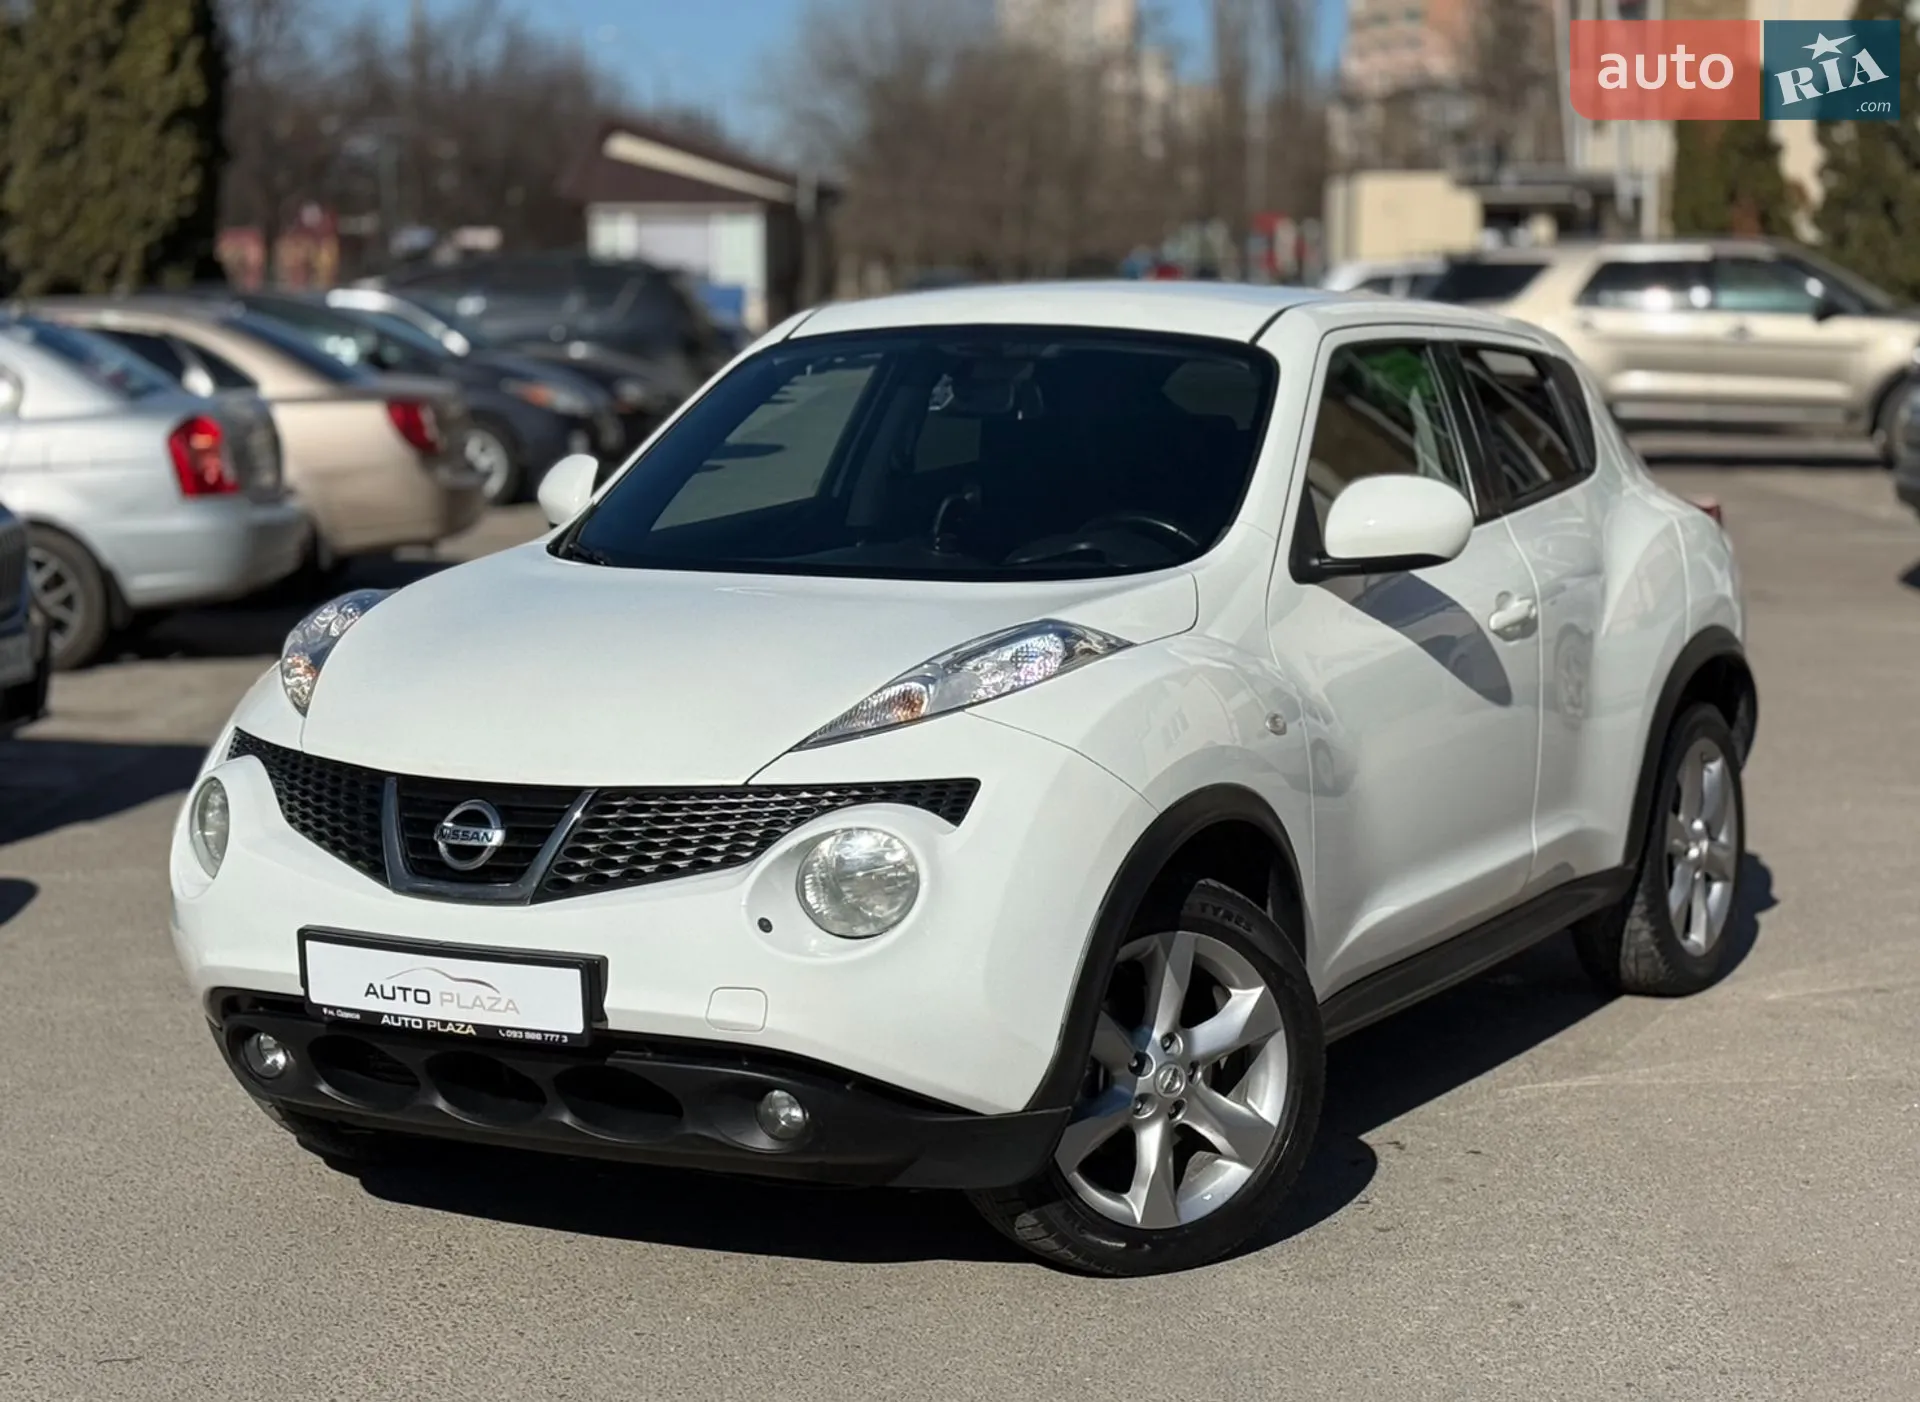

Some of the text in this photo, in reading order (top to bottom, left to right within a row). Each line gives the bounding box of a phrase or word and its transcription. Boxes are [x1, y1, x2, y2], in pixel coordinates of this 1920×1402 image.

[439, 826, 495, 842] NISSAN
[364, 982, 520, 1015] AUTO PLAZA
[381, 1014, 477, 1036] AUTO PLAZA
